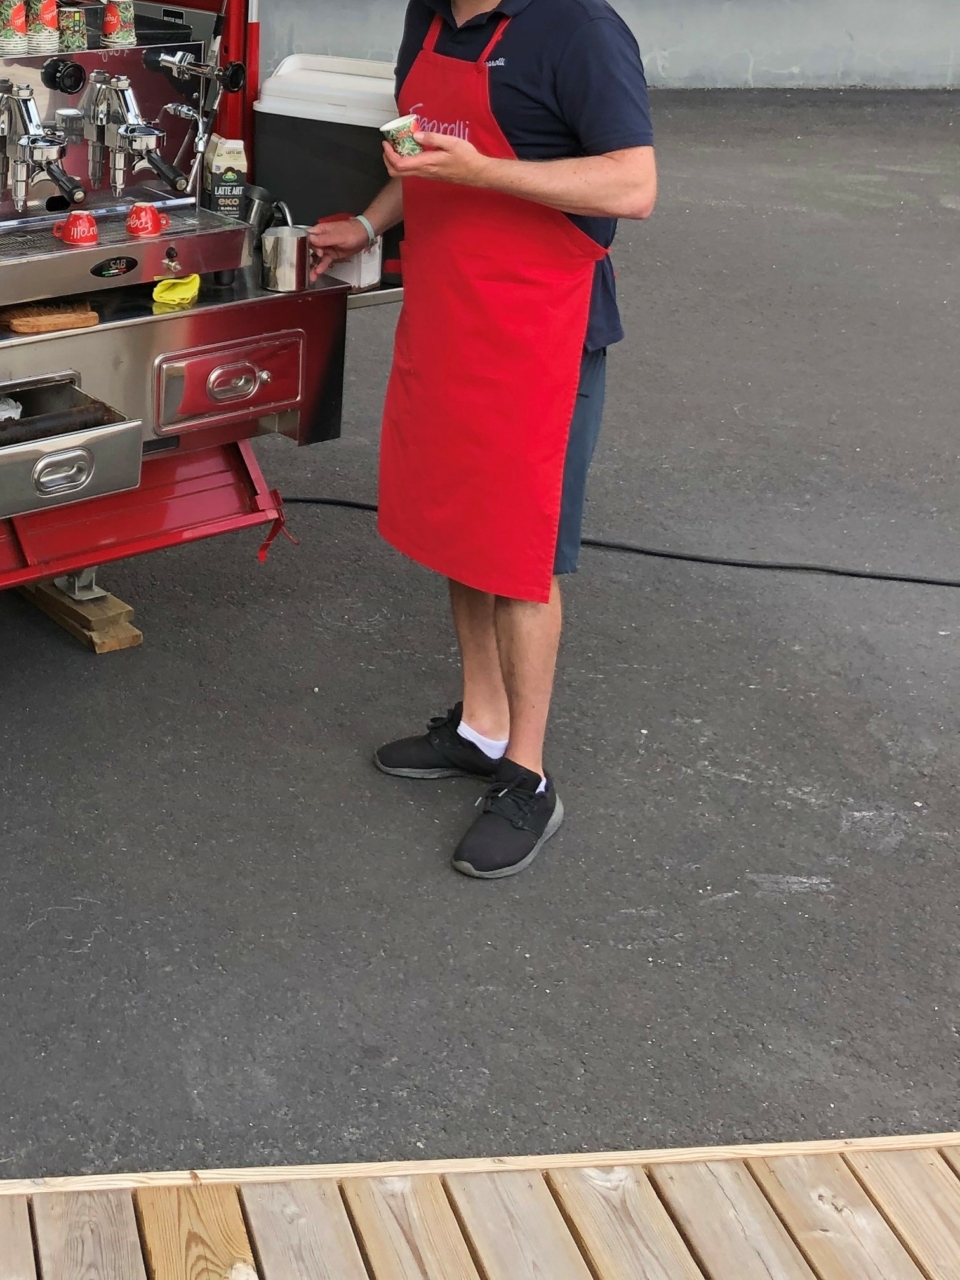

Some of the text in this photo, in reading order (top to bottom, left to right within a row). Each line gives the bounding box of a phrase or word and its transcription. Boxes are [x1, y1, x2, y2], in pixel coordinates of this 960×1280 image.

[409, 103, 470, 141] garolli
[214, 186, 244, 195] LATTE ART
[109, 259, 127, 270] SAB
